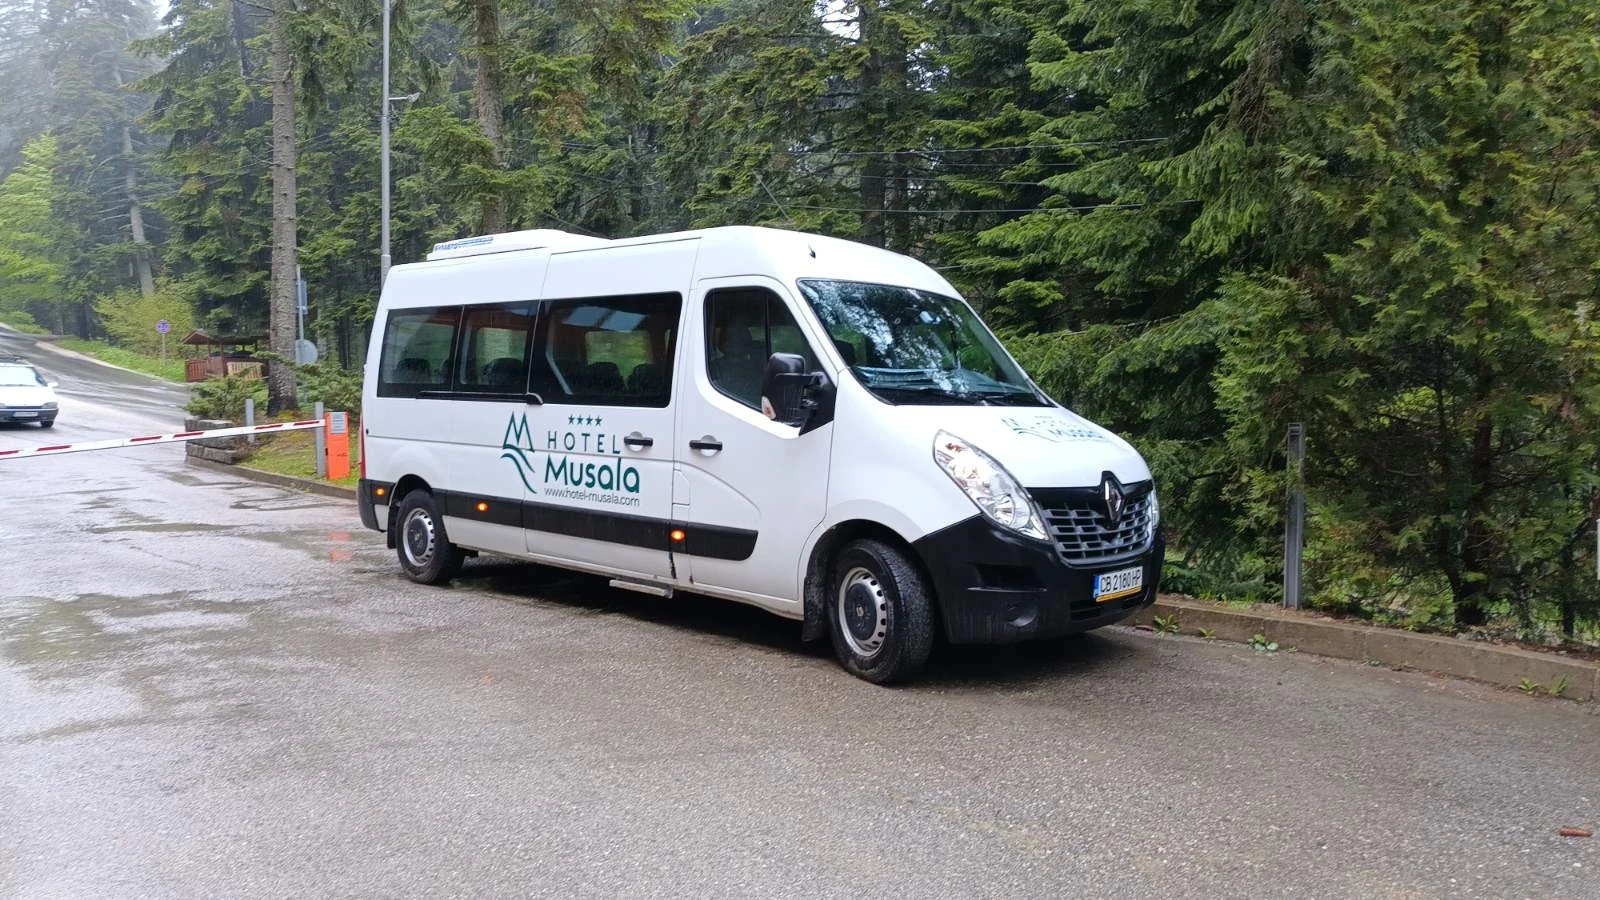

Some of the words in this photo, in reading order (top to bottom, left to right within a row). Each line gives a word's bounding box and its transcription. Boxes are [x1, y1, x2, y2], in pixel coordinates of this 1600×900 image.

[547, 431, 621, 454] HOTEL
[544, 454, 640, 493] Musala
[544, 487, 640, 507] www.hotel-musala.com
[1101, 576, 1111, 592] CB
